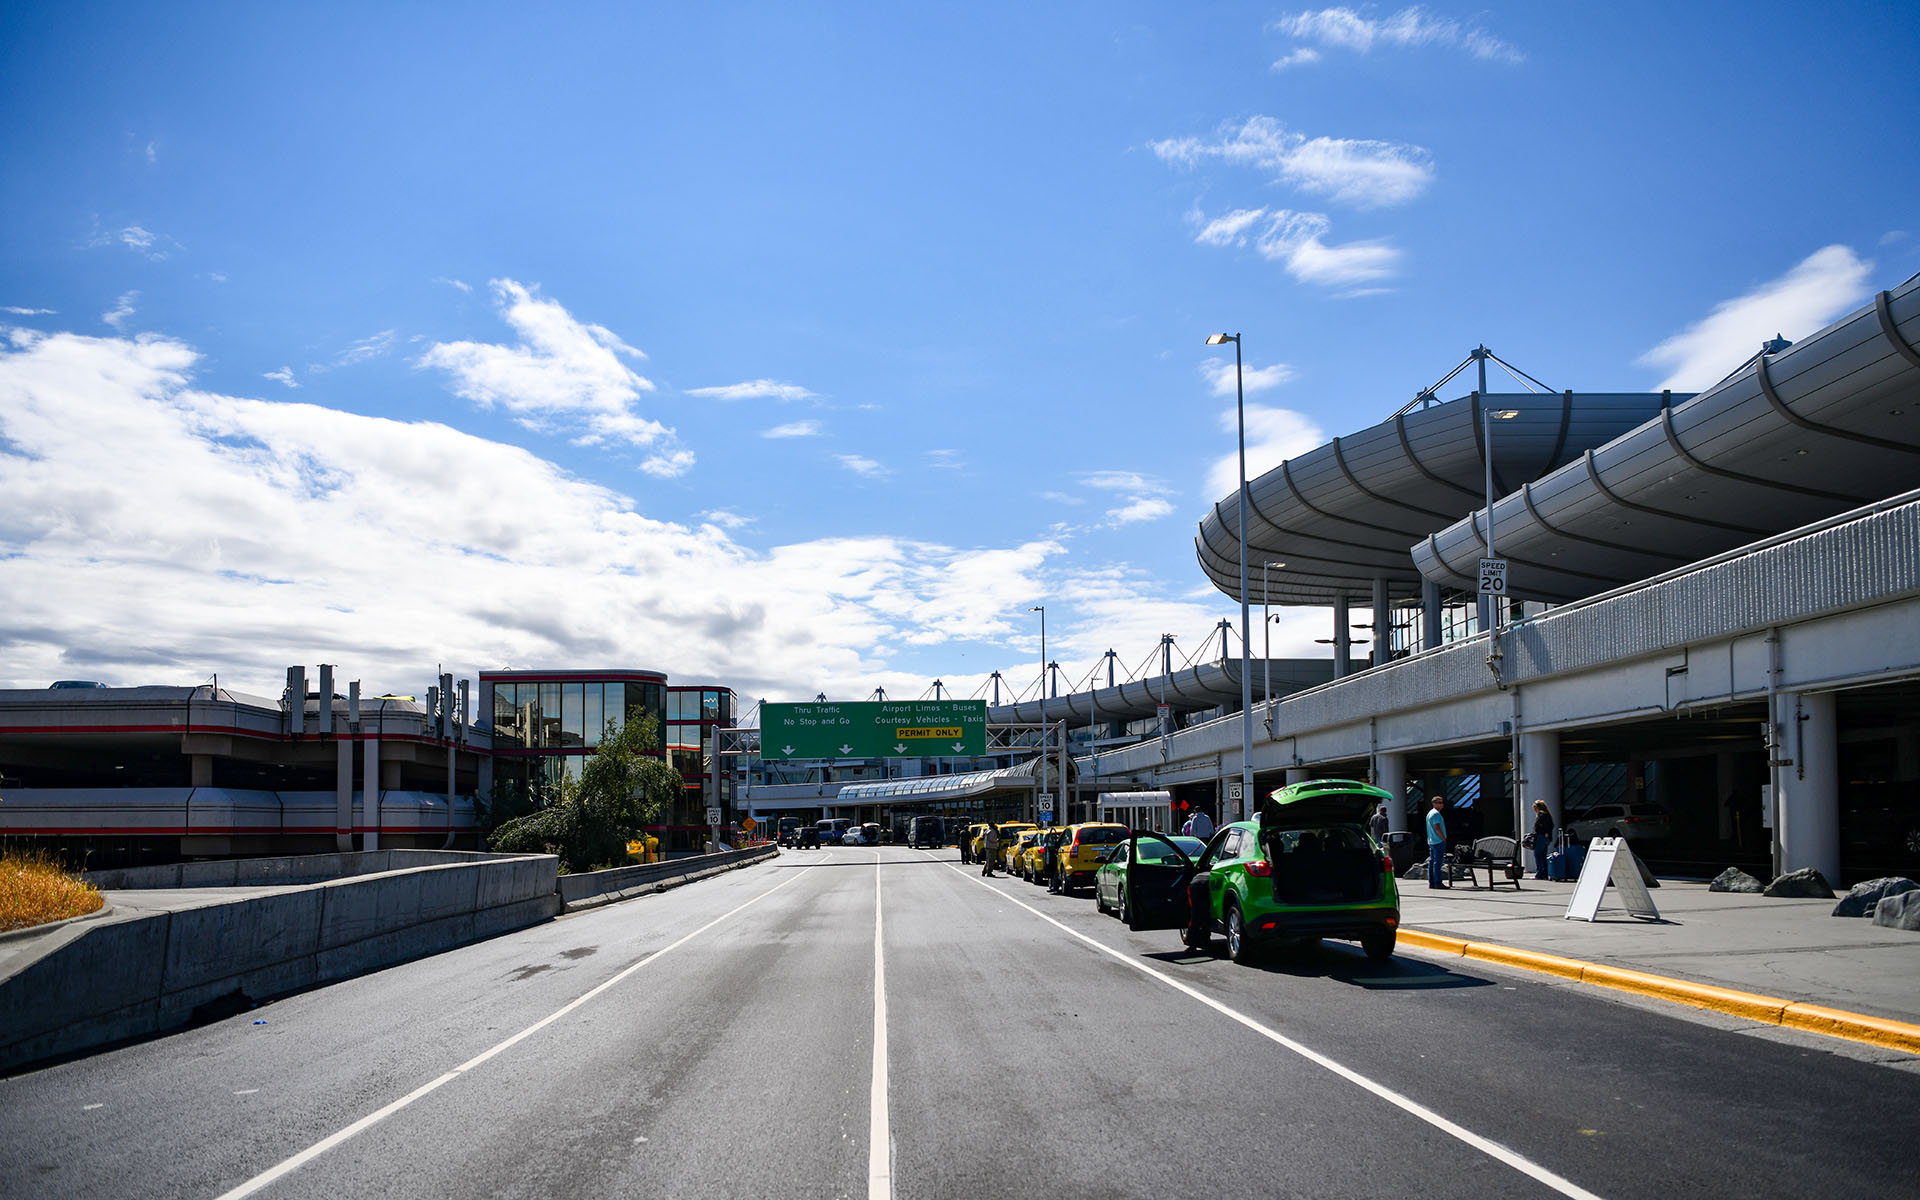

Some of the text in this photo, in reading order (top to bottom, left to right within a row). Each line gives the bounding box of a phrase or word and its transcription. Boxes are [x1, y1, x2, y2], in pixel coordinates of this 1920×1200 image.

[1481, 577, 1503, 590] 20
[794, 706, 811, 714] Thru
[882, 705, 911, 714] Airport
[800, 718, 816, 726] Stop
[875, 716, 910, 725] Courtesy
[899, 728, 960, 737] PERMIT ONLY
